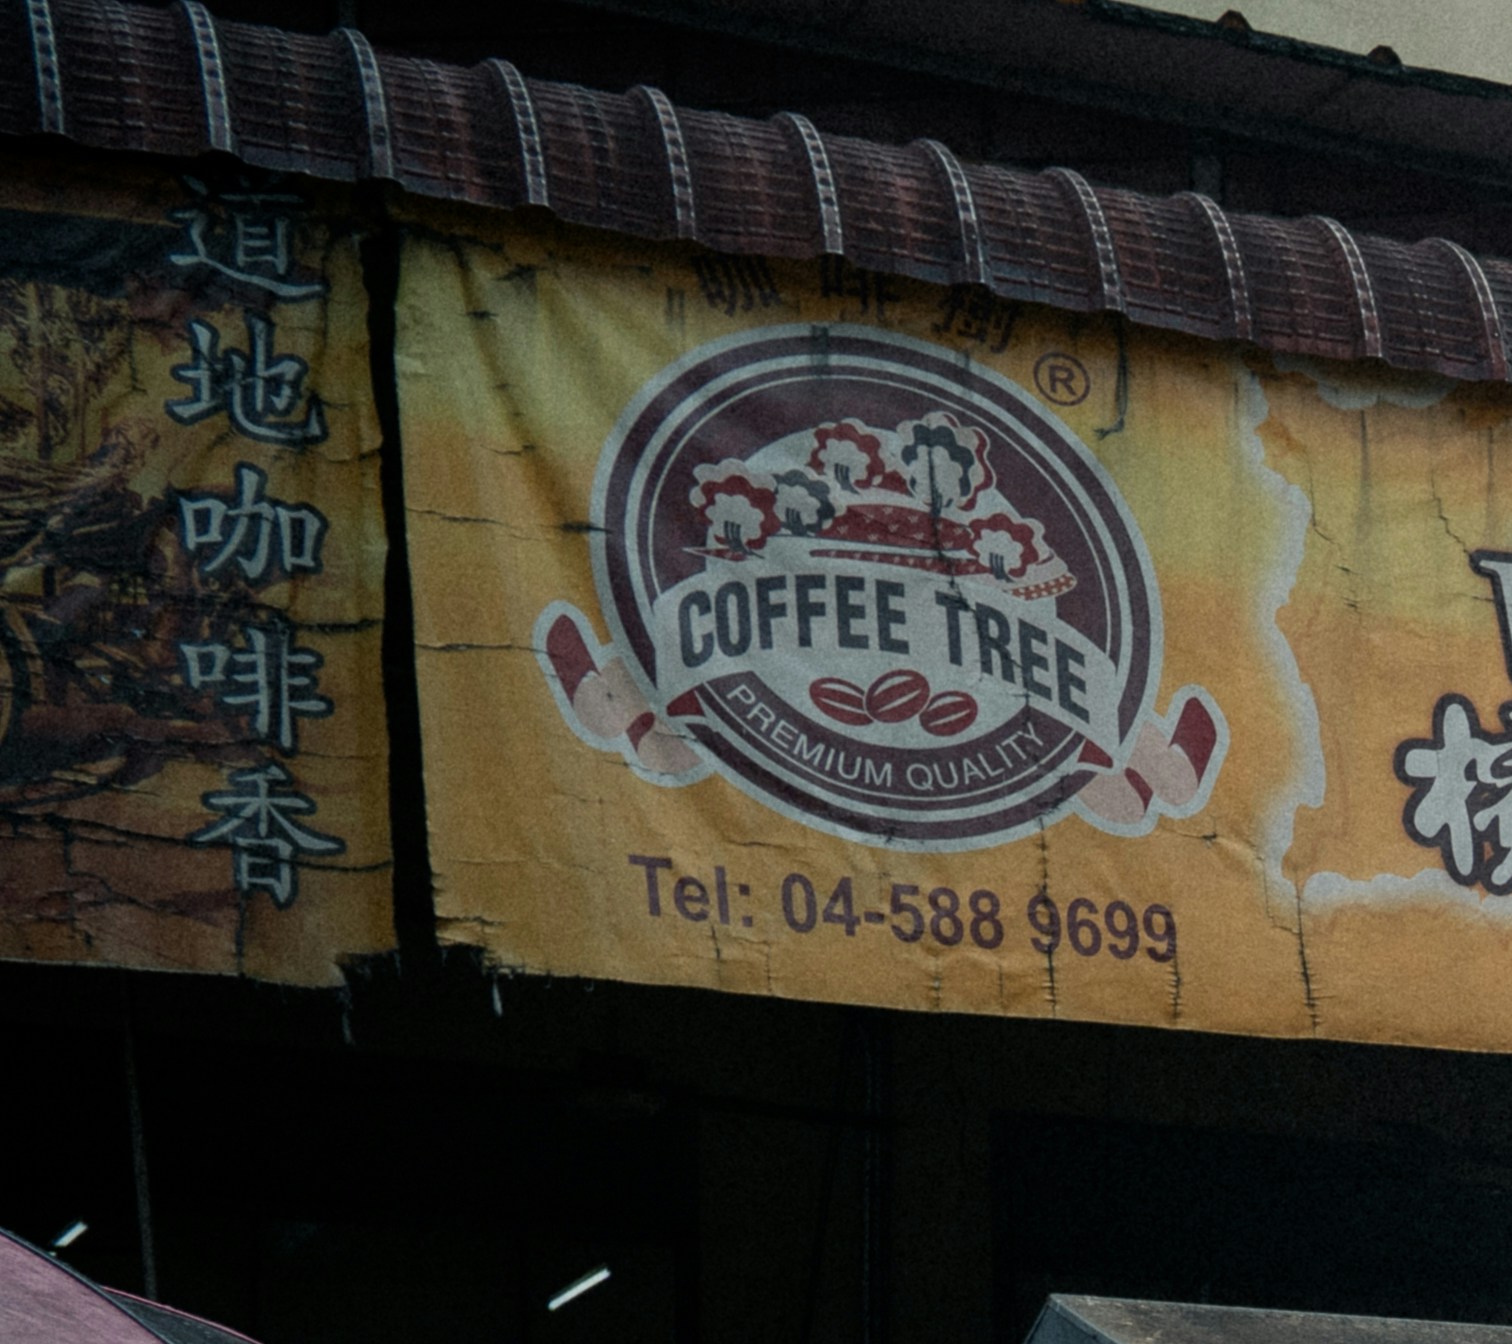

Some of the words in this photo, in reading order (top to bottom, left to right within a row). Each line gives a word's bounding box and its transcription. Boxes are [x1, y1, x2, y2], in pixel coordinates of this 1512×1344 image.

[678, 574, 911, 668] COFFEE
[936, 591, 1091, 724] TREE
[727, 684, 893, 787] PREMIUM
[903, 722, 1046, 792] QUALITY
[628, 855, 752, 928] Tel:
[780, 873, 1004, 950] 04-588
[1026, 896, 1178, 963] 9699
